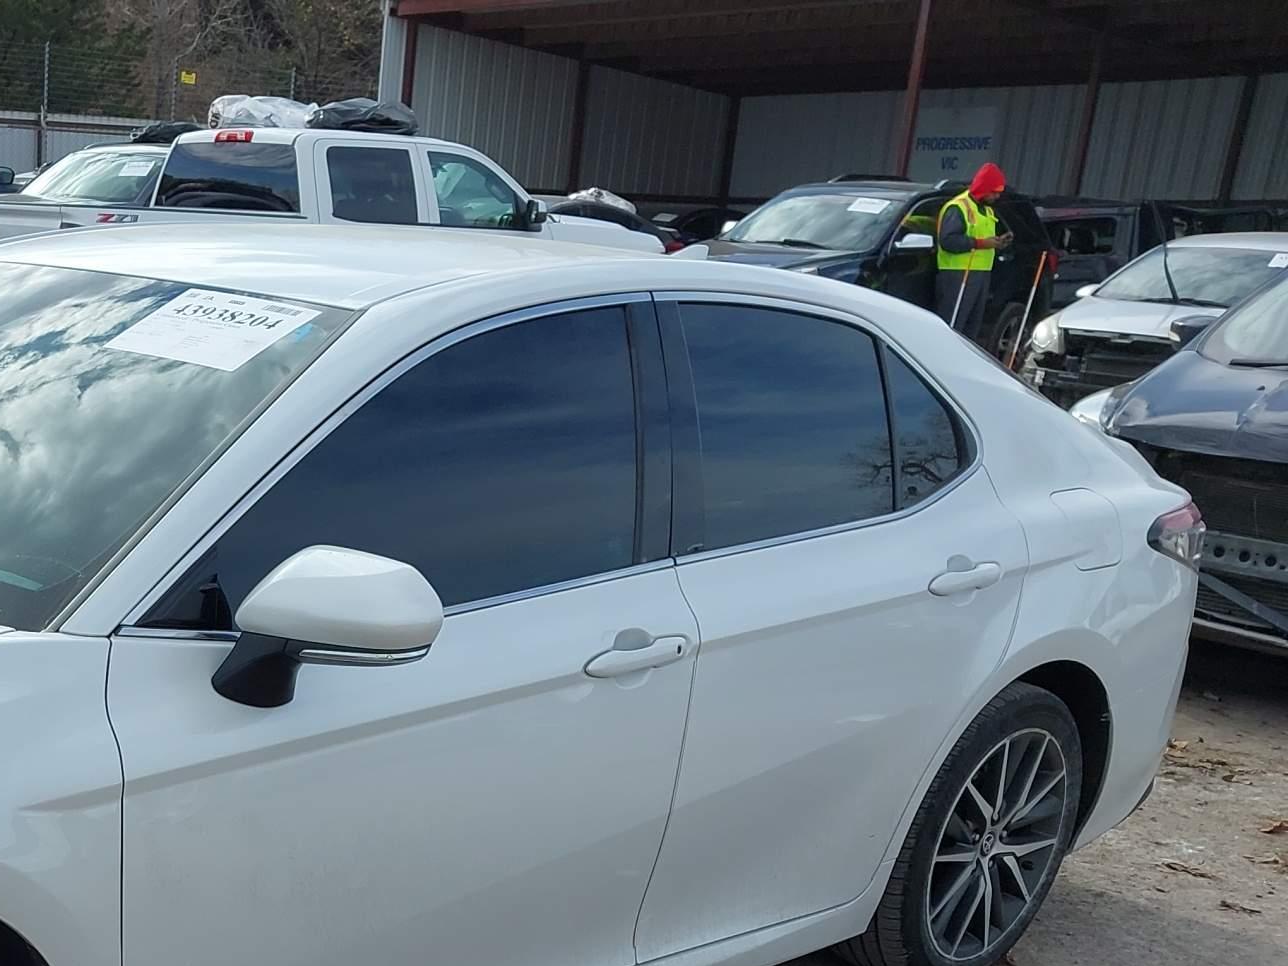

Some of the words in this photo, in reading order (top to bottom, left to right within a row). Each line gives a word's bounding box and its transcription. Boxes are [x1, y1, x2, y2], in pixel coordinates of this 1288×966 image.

[915, 136, 993, 151] PROGRESSIVE
[941, 156, 959, 170] VIC
[95, 213, 140, 224] Z71
[173, 303, 284, 330] 43938204
